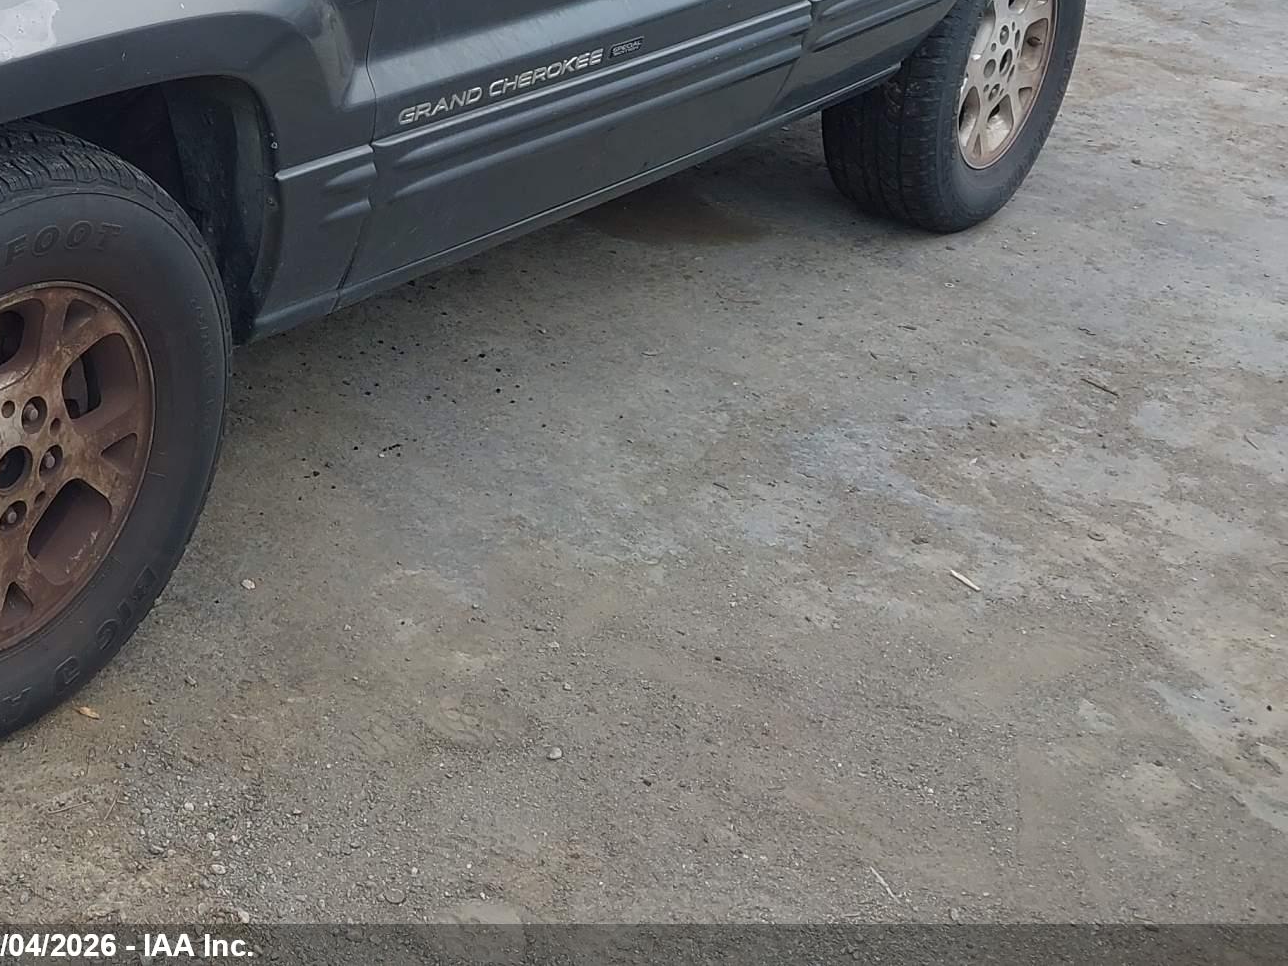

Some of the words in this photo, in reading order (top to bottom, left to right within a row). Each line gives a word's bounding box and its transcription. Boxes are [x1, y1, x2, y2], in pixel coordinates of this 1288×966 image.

[398, 86, 483, 125] GRAND
[488, 48, 604, 97] CHEROKEE
[4, 220, 123, 267] FOOT
